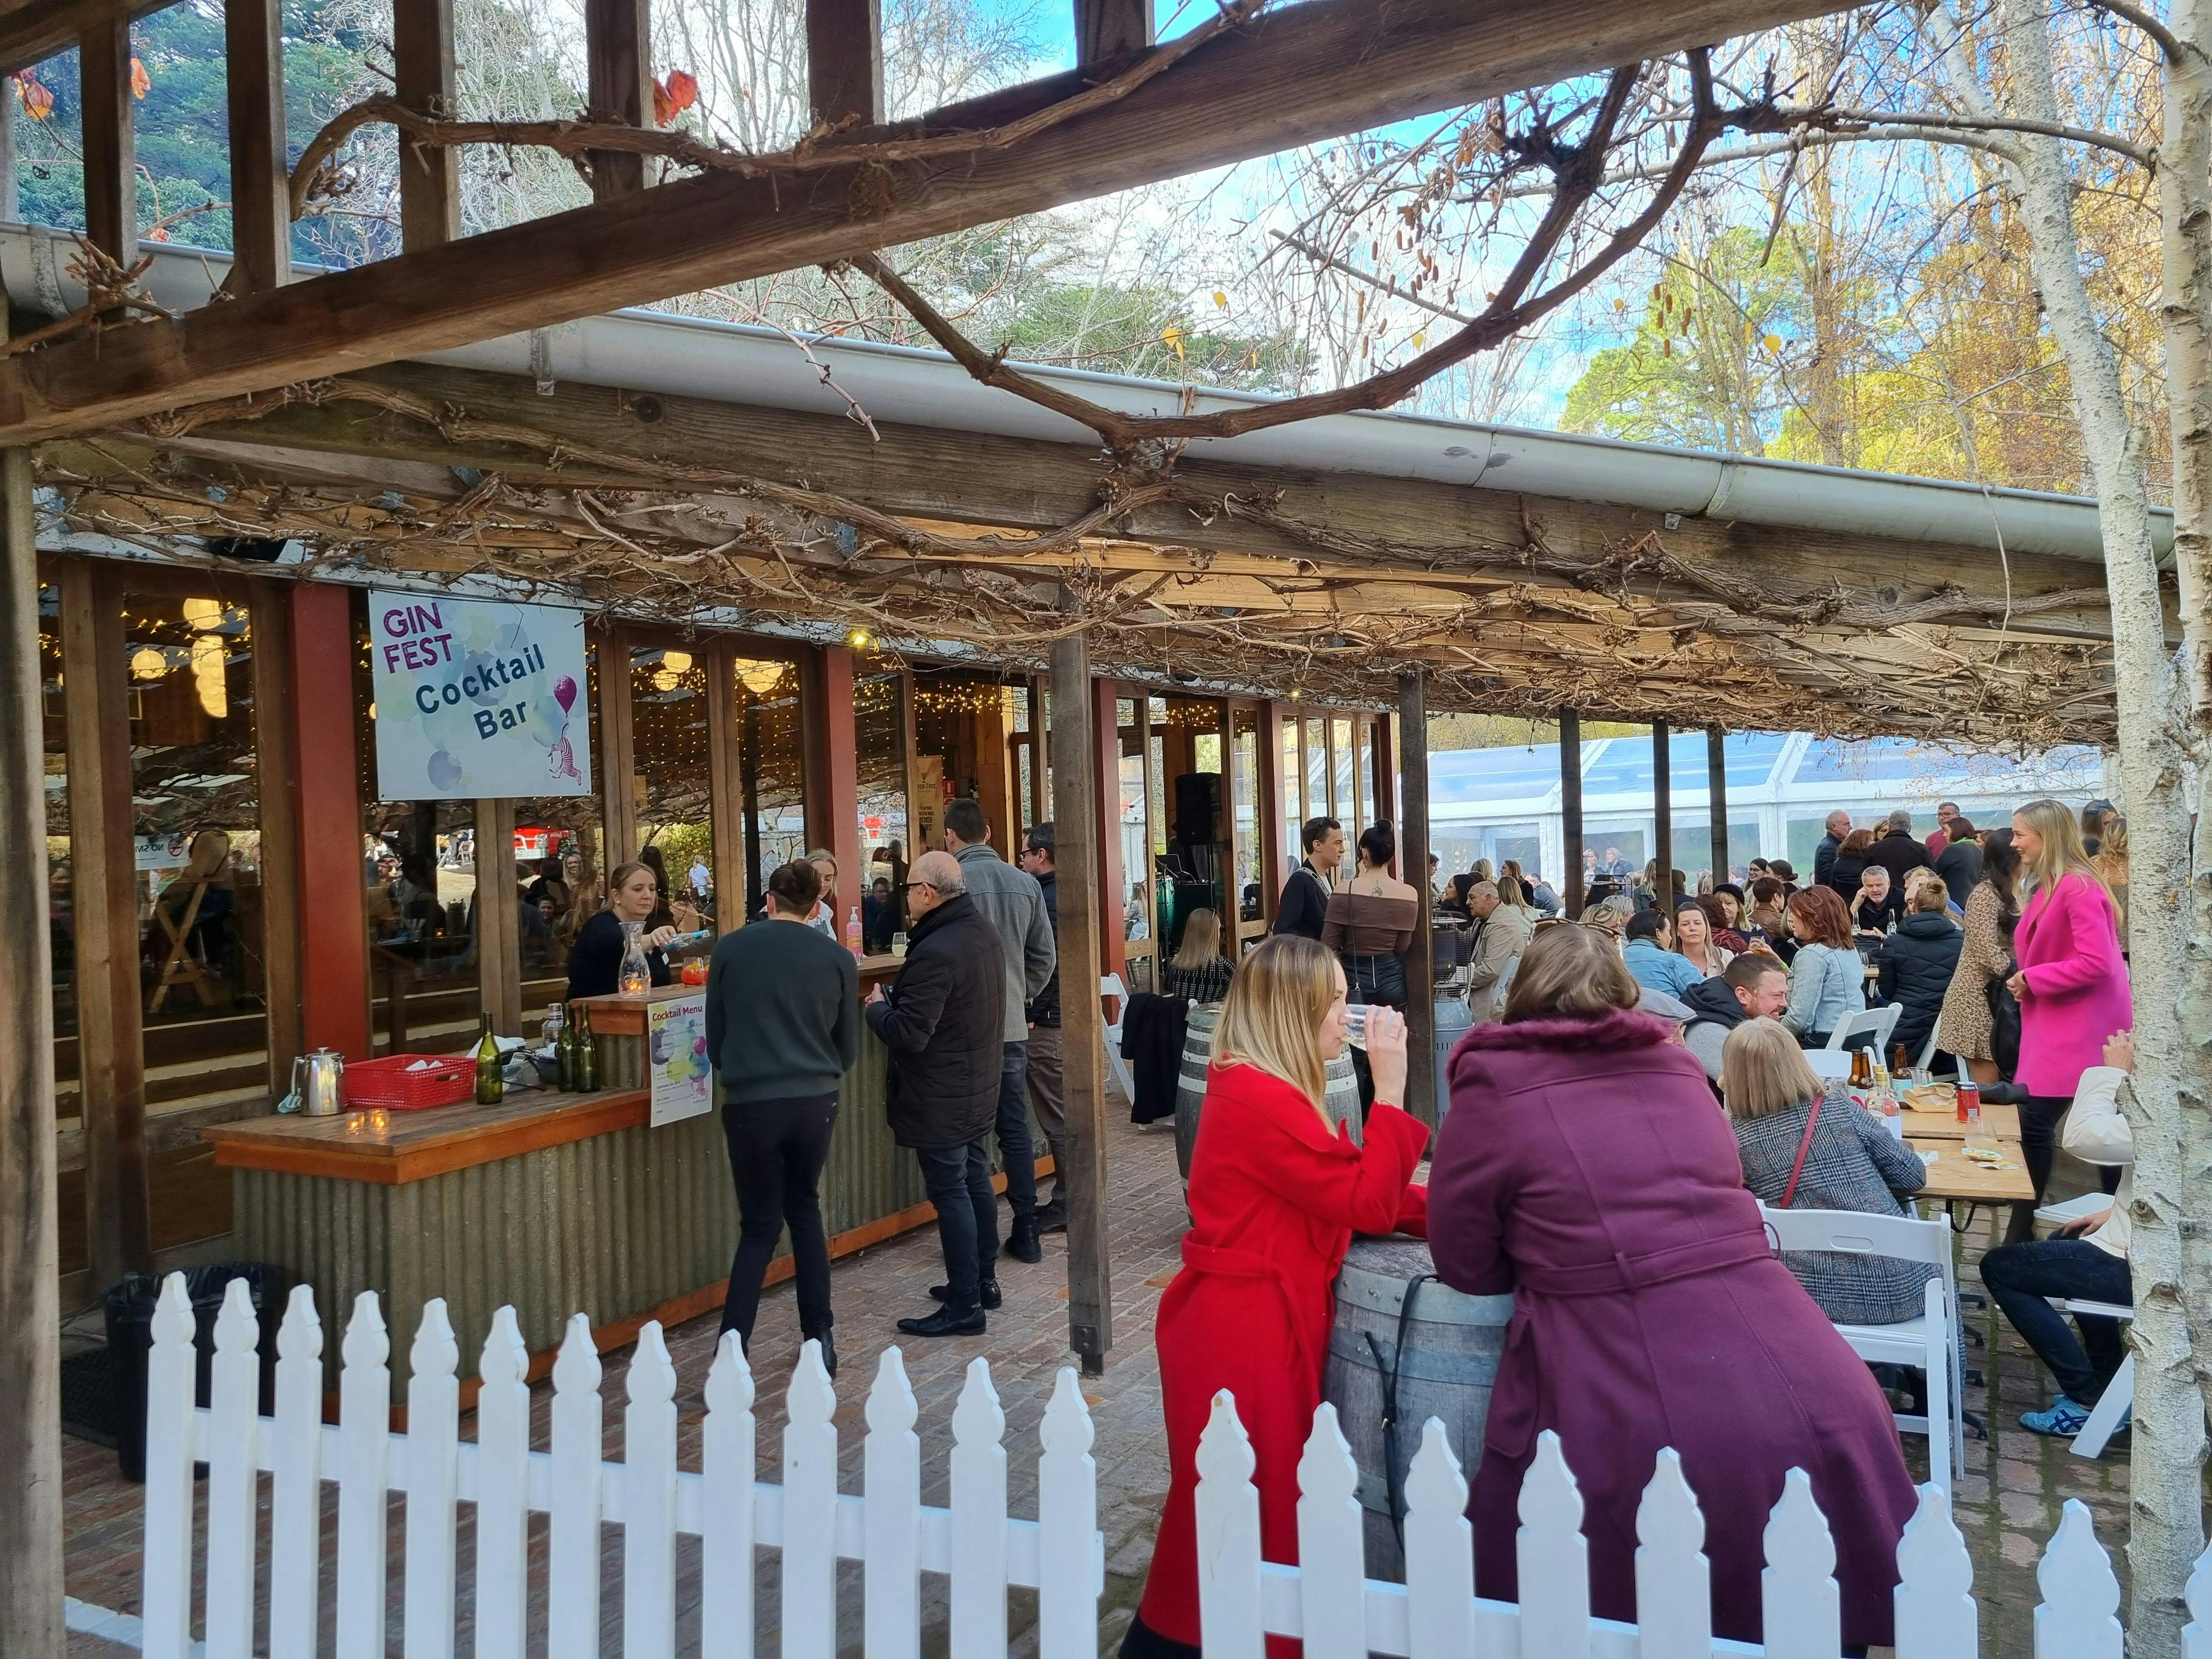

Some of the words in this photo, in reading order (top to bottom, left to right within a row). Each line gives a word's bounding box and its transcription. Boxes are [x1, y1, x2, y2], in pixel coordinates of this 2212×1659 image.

[383, 602, 443, 638] GIN
[383, 633, 453, 674] FEST
[415, 643, 545, 714] Cocktail
[473, 701, 527, 740] Bar
[652, 1008, 681, 1022] Cocktail
[682, 1006, 702, 1015] Menu
